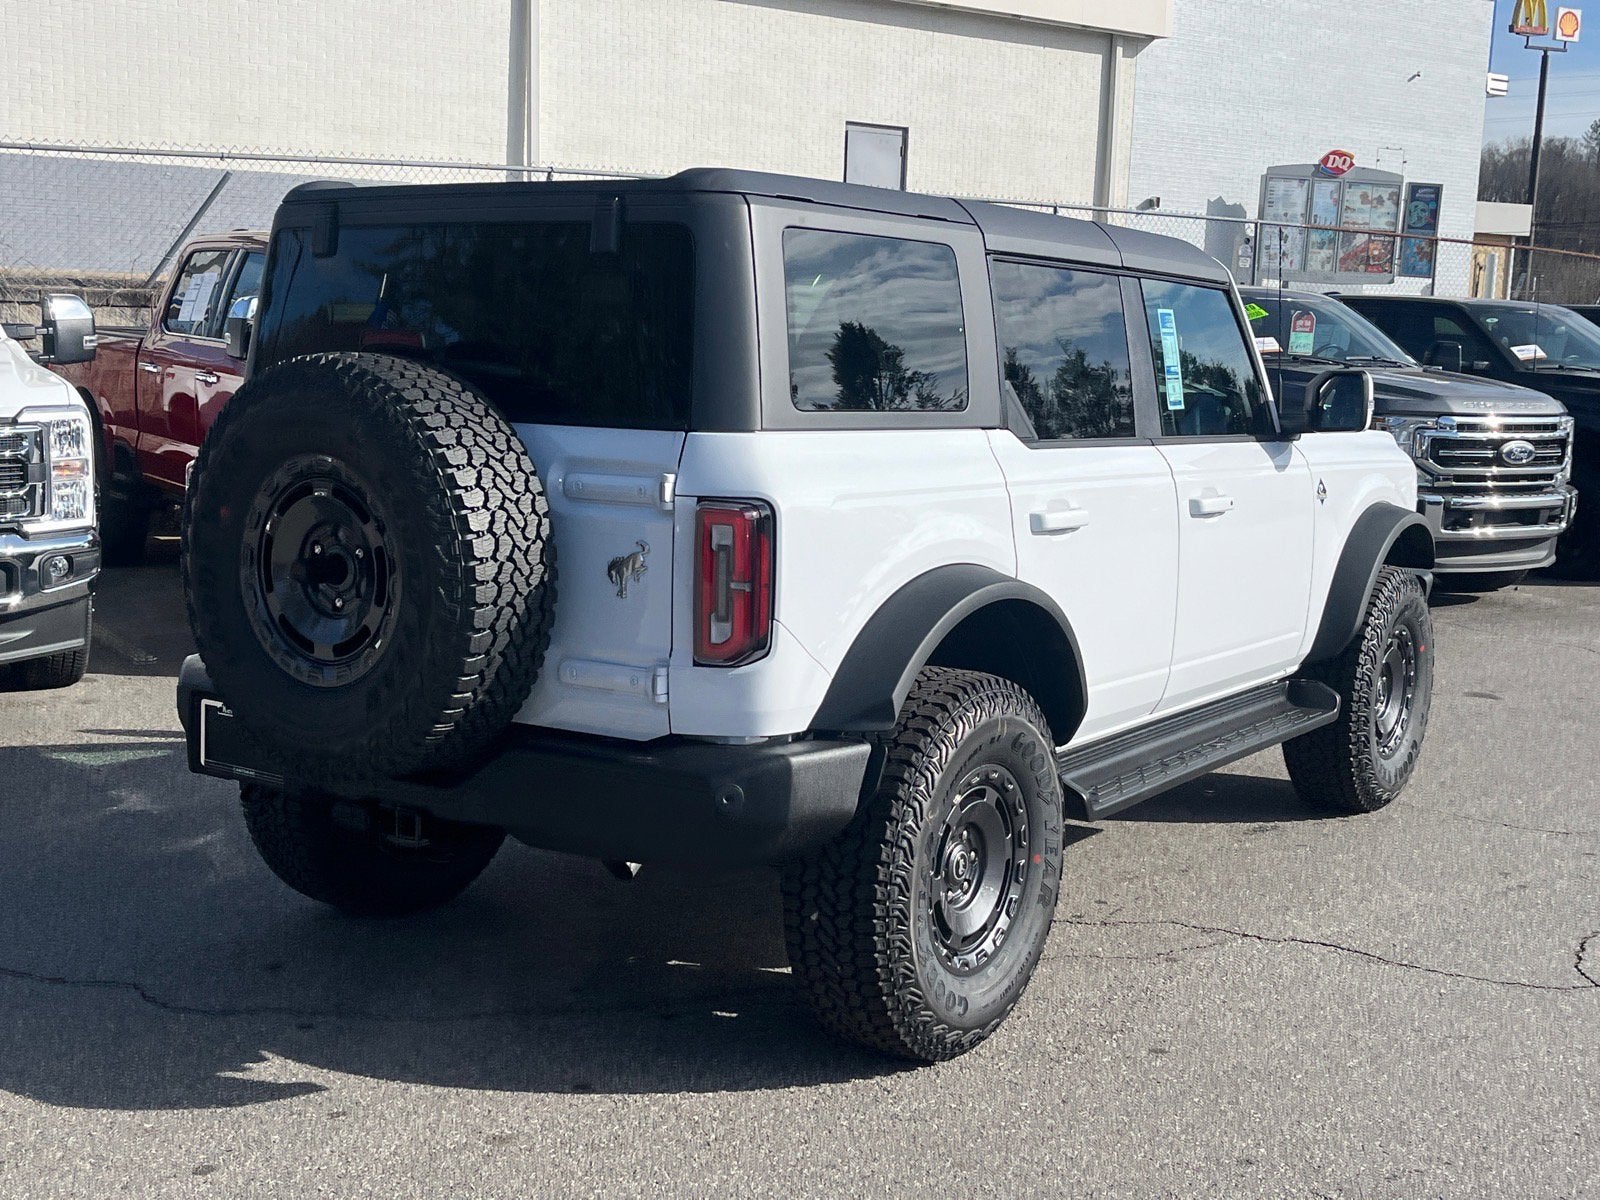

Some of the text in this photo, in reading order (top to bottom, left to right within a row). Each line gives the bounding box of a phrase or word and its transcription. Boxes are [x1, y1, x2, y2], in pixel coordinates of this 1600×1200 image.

[1326, 154, 1351, 171] DQ
[1511, 447, 1529, 460] Ford
[1011, 732, 1059, 908] GOODYEAR
